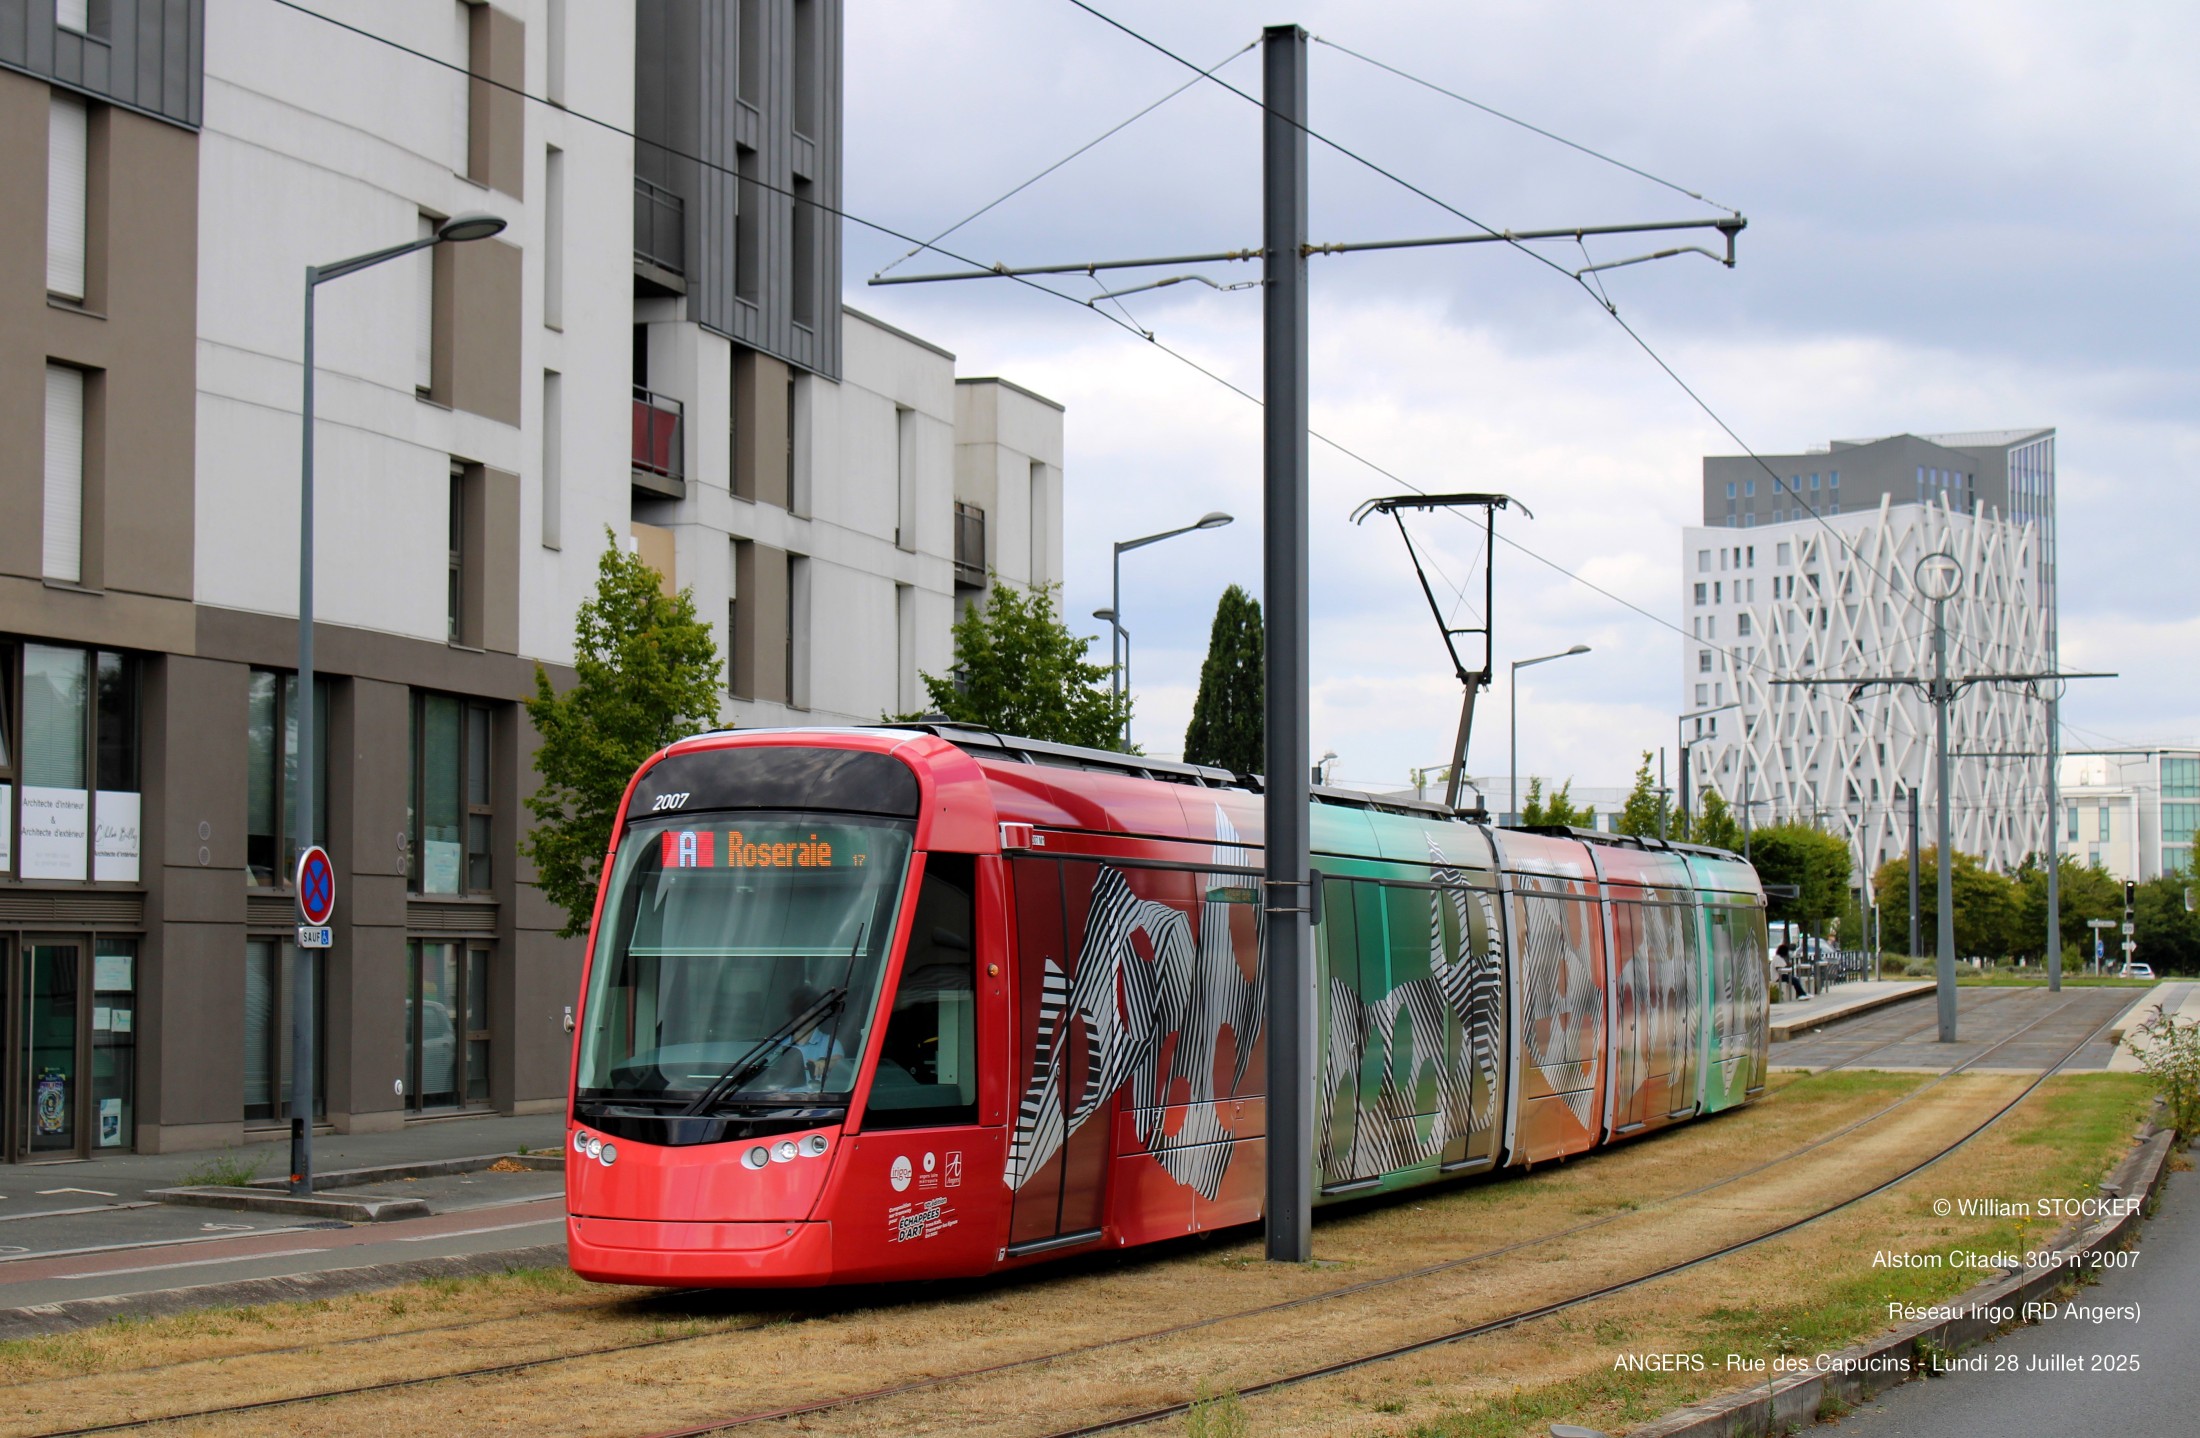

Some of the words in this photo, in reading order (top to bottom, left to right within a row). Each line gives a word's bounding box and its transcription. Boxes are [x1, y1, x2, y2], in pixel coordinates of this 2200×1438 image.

[23, 798, 53, 808] Architecte
[653, 793, 690, 811] 2007
[50, 816, 56, 824] &
[21, 827, 52, 837] Architecte
[679, 832, 697, 867] A
[728, 831, 832, 867] Roseraie
[303, 931, 321, 943] SAUF
[899, 1207, 940, 1229] ÉCHAPPÉES
[898, 1224, 924, 1242] D'ART
